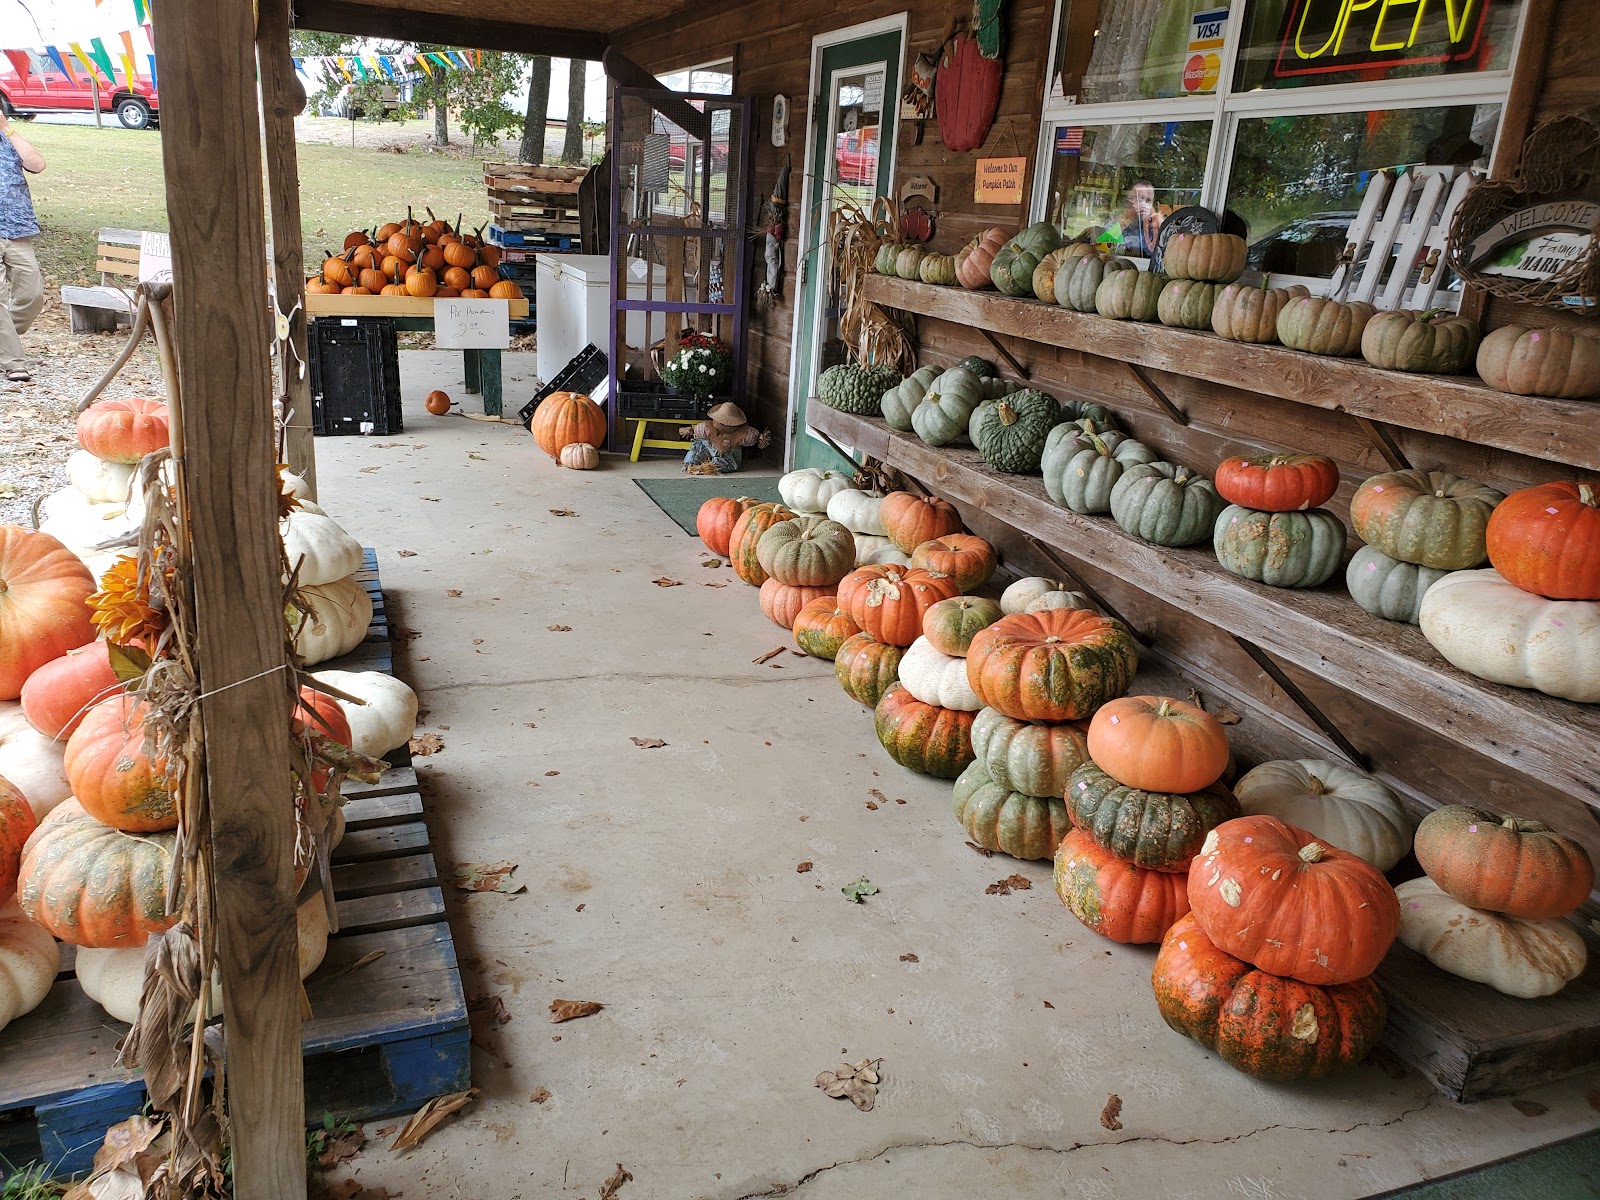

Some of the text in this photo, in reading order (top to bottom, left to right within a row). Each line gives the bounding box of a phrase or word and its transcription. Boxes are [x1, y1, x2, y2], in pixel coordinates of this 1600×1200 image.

[1197, 23, 1221, 39] VISA
[1184, 67, 1219, 79] MasterCard
[983, 163, 1003, 174] Welcome
[982, 178, 1016, 191] Pumpkin Patch
[1500, 204, 1597, 235] WELCOME
